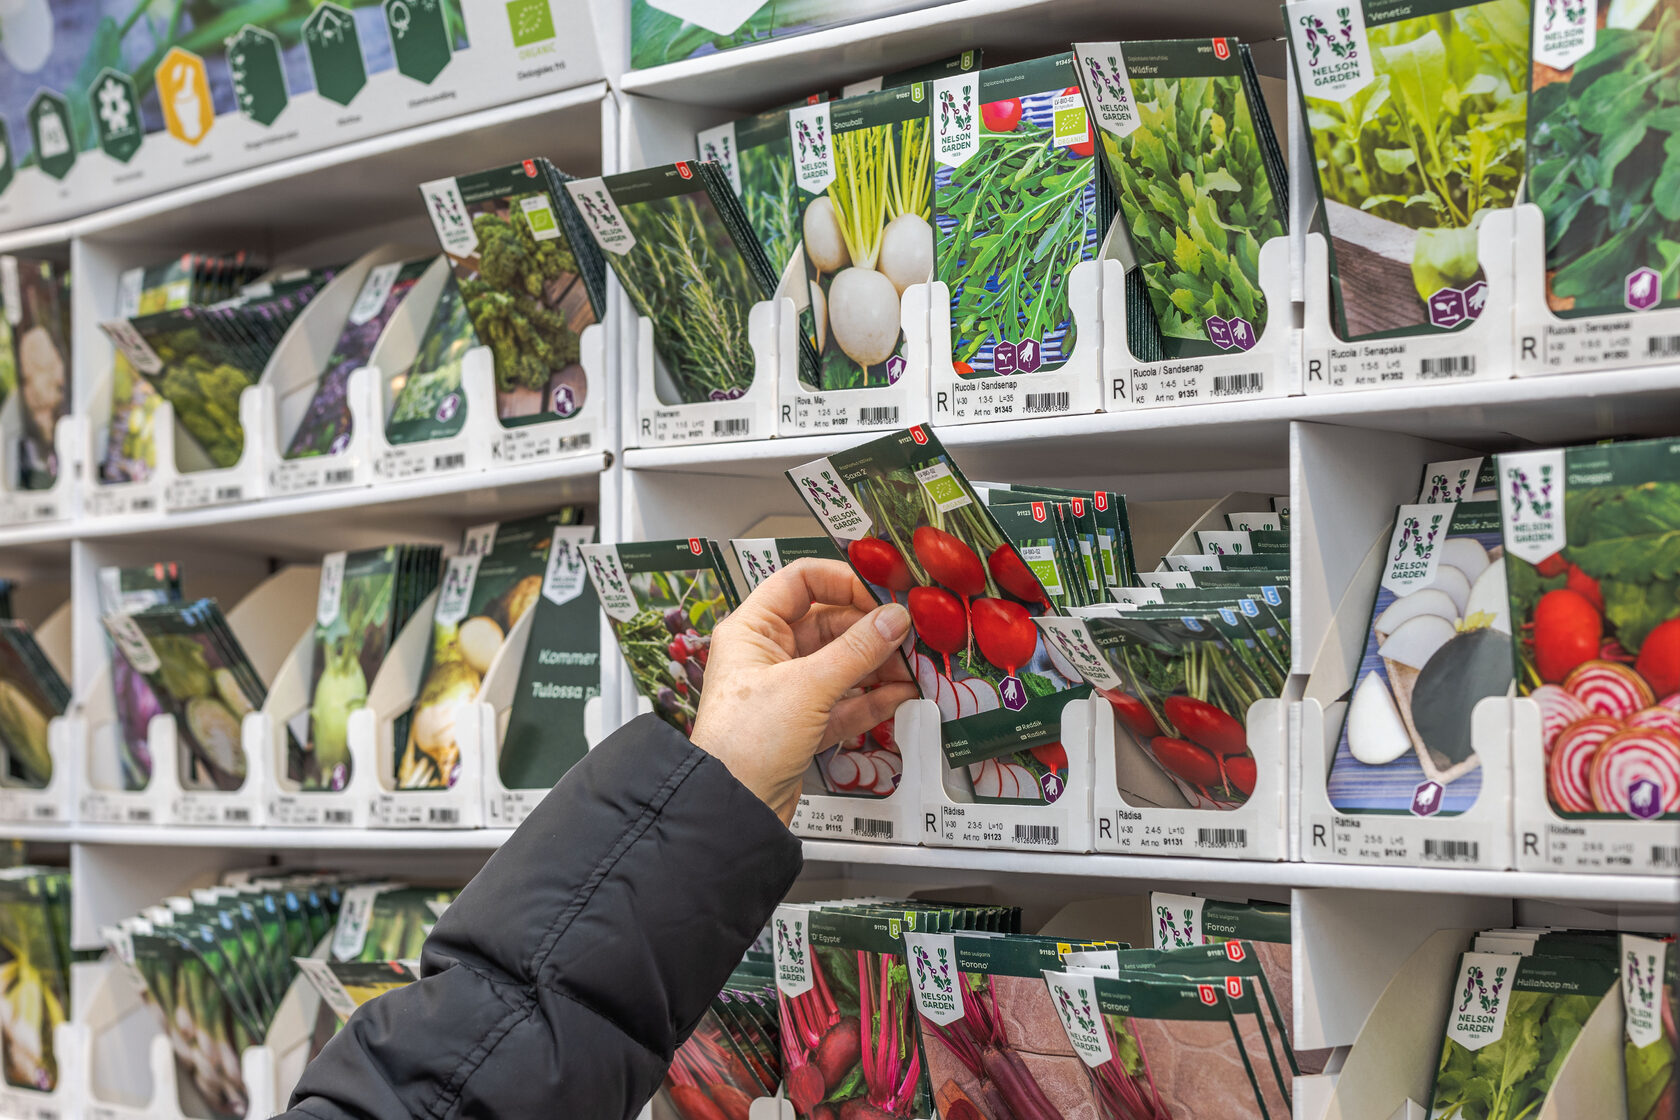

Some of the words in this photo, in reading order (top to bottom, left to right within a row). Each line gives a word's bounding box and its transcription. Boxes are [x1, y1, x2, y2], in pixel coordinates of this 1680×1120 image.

[1217, 43, 1226, 56] D
[964, 56, 970, 67] B
[1128, 66, 1158, 74] 'Wildfire'
[1312, 60, 1358, 76] NELSON
[1314, 70, 1360, 86] GARDEN
[914, 88, 921, 98] B
[942, 132, 971, 144] NELSON
[942, 142, 971, 152] GARDEN
[802, 161, 828, 171] NELSON
[802, 169, 828, 179] GARDEN
[1522, 337, 1536, 360] R
[1134, 368, 1156, 378] Rucola
[1163, 364, 1204, 374] Sandsenap
[1308, 360, 1322, 381] R
[954, 383, 976, 392] Rucola
[982, 381, 1018, 390] Sandsenap
[1114, 379, 1126, 399] R
[1178, 390, 1198, 398] 91351
[937, 392, 948, 412] R
[782, 405, 792, 423] R
[642, 418, 651, 436] R
[916, 430, 924, 442] D
[1074, 502, 1081, 514] D
[1098, 496, 1104, 508] D
[828, 510, 857, 524] NELSON
[1036, 506, 1043, 518] D
[834, 516, 862, 530] GARDEN
[692, 542, 700, 552] D
[1393, 562, 1428, 570] NELSON
[1391, 570, 1426, 580] GARDEN
[1268, 591, 1276, 600] E
[538, 649, 598, 666] Kommer
[532, 682, 583, 699] Tulossa
[826, 824, 842, 832] 91115
[926, 814, 936, 832] R
[1100, 819, 1112, 838] R
[1313, 824, 1326, 846] R
[1523, 832, 1539, 856] R
[892, 926, 899, 935] B
[1206, 922, 1236, 934] 'Forono'
[1231, 946, 1240, 958] D
[780, 965, 804, 974] NELSON
[960, 960, 988, 970] 'Forono'
[780, 973, 806, 982] GARDEN
[1230, 981, 1240, 994] D
[1517, 978, 1560, 990] Hullahoop
[1563, 982, 1580, 990] mix
[921, 992, 954, 1002] NELSON
[1204, 988, 1214, 1002] D
[922, 1001, 954, 1010] GARDEN
[1100, 1001, 1130, 1012] 'Forono'
[1459, 1014, 1494, 1024] NELSON
[1457, 1024, 1494, 1032] GARDEN
[1070, 1032, 1099, 1044] NELSON
[1073, 1040, 1102, 1052] GARDEN
